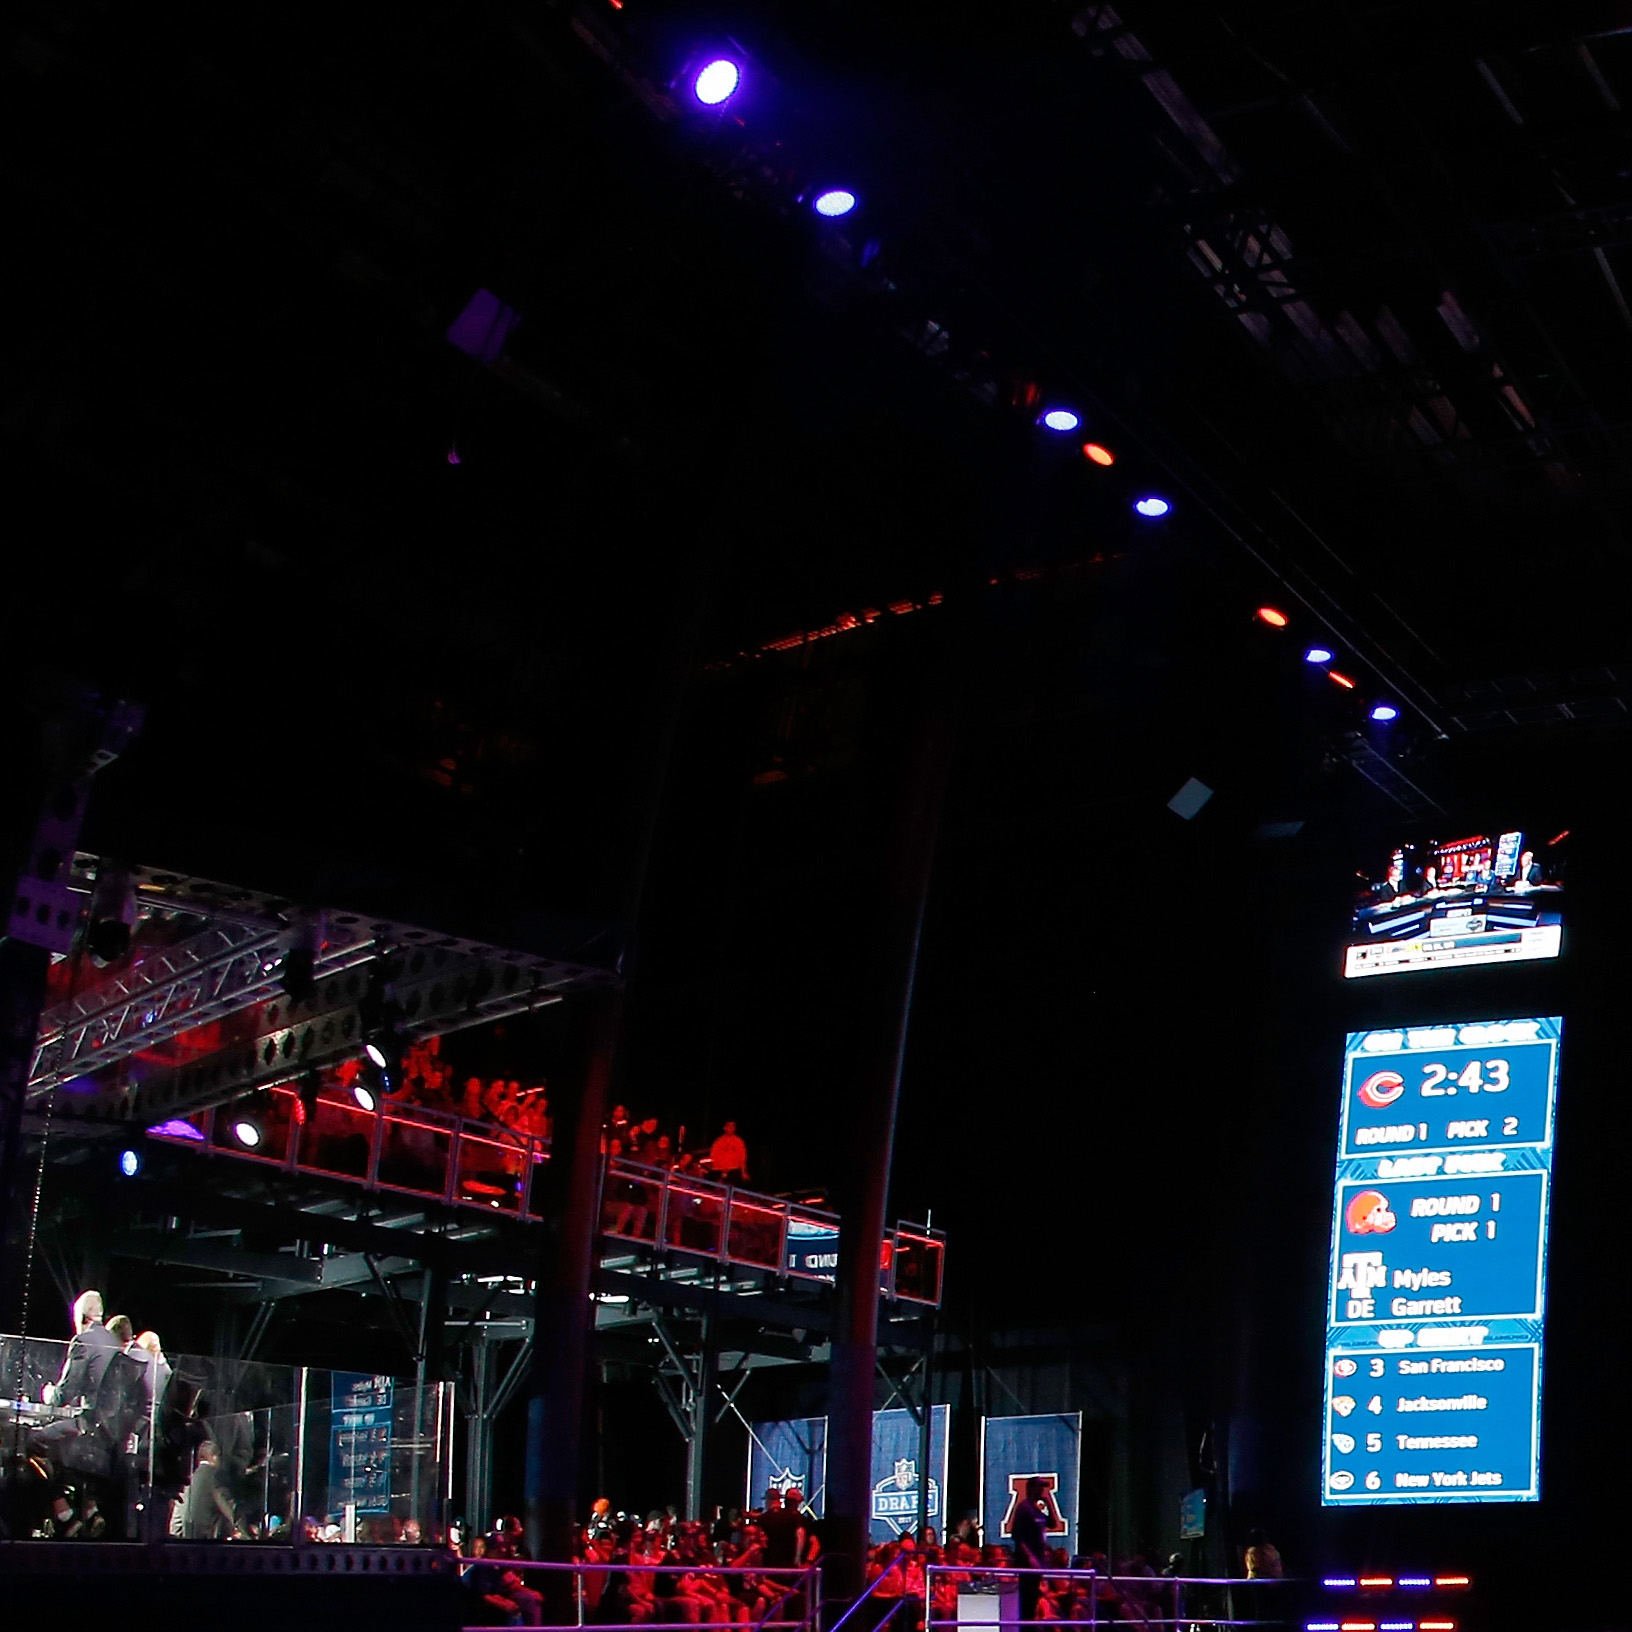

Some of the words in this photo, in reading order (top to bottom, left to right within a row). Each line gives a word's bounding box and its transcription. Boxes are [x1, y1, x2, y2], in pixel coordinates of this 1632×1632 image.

[1420, 1058, 1511, 1098] 2:43
[1355, 1123, 1417, 1146] ROUND
[1446, 1119, 1491, 1140] PICK
[1502, 1116, 1519, 1136] 2
[1411, 1195, 1482, 1218] ROUND
[1489, 1192, 1501, 1213] 1
[1430, 1222, 1479, 1243] PICK
[1485, 1219, 1497, 1240] 1
[1392, 1268, 1452, 1292] Myles
[1346, 1298, 1377, 1319] DE
[1391, 1296, 1462, 1317] Garrett
[1369, 1359, 1386, 1378] 3
[1398, 1359, 1430, 1376] San
[1430, 1358, 1506, 1374] Francisco
[1367, 1395, 1384, 1415] 4
[1396, 1396, 1489, 1413] Jacksonville
[1366, 1433, 1383, 1453] 5
[1396, 1433, 1479, 1451] Tennessee
[1364, 1471, 1381, 1491] 6
[1394, 1472, 1430, 1488] New
[1431, 1471, 1470, 1487] York
[1470, 1470, 1504, 1486] Jets
